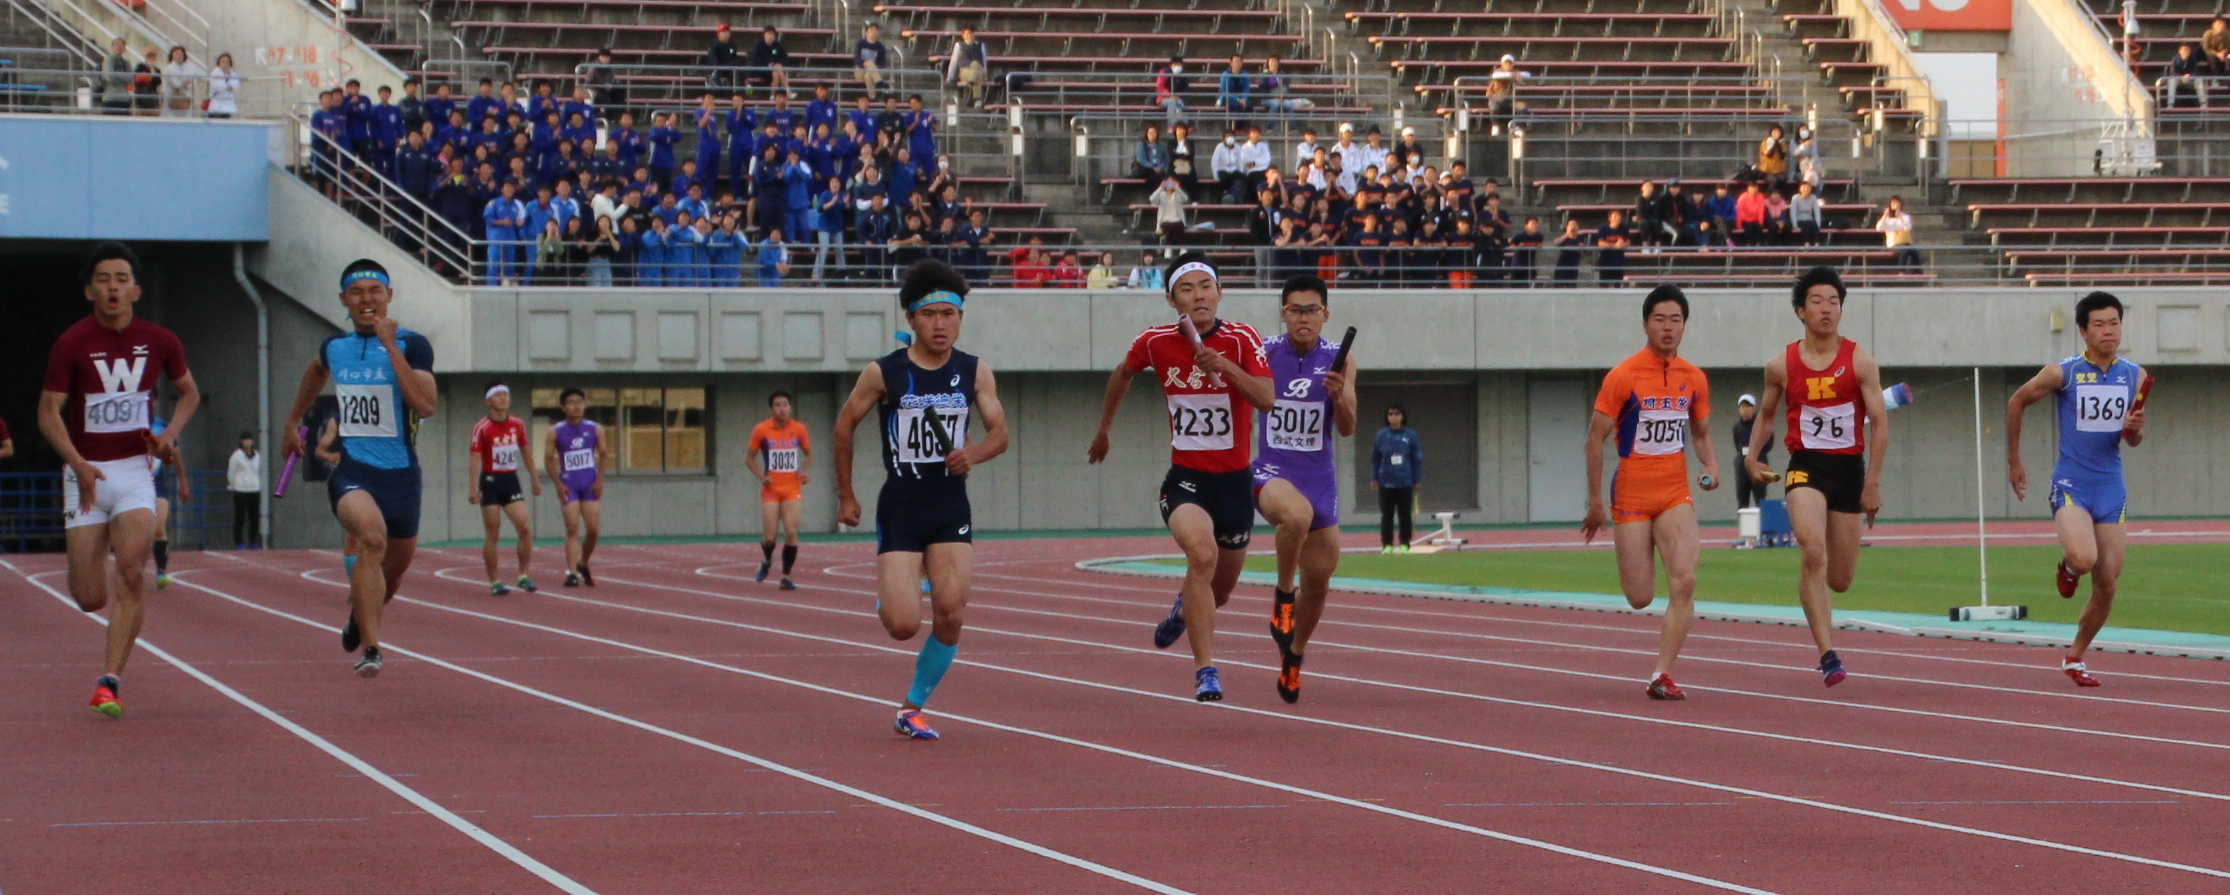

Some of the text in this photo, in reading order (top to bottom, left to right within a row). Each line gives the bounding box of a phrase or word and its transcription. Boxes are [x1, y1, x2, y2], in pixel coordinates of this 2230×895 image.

[93, 357, 147, 392] W
[1283, 377, 1312, 398] B
[1806, 376, 1836, 400] K
[341, 395, 380, 425] 1209
[1642, 396, 1688, 410] 埼玉栄
[2080, 396, 2124, 420] 1369
[1173, 407, 1230, 436] 4233
[1271, 406, 1320, 434] 5012
[1272, 434, 1315, 447] 西武文理
[566, 452, 590, 468] 5017
[771, 451, 795, 470] 3032
